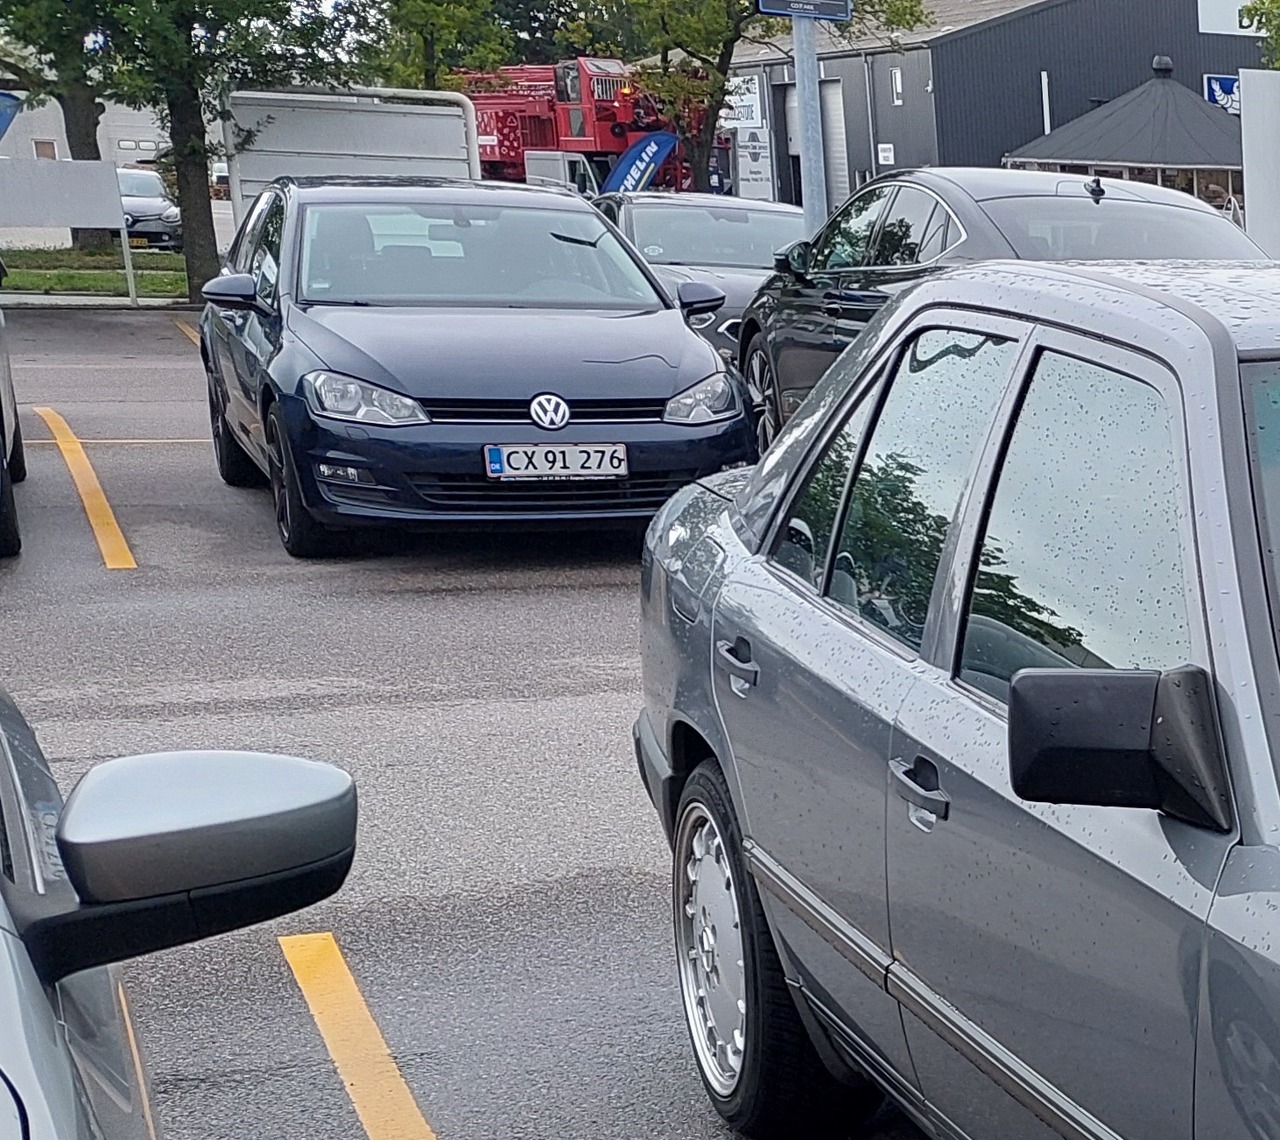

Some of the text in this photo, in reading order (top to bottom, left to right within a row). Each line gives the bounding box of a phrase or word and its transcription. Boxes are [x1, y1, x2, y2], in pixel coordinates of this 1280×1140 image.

[506, 449, 623, 470] CX 91 276
